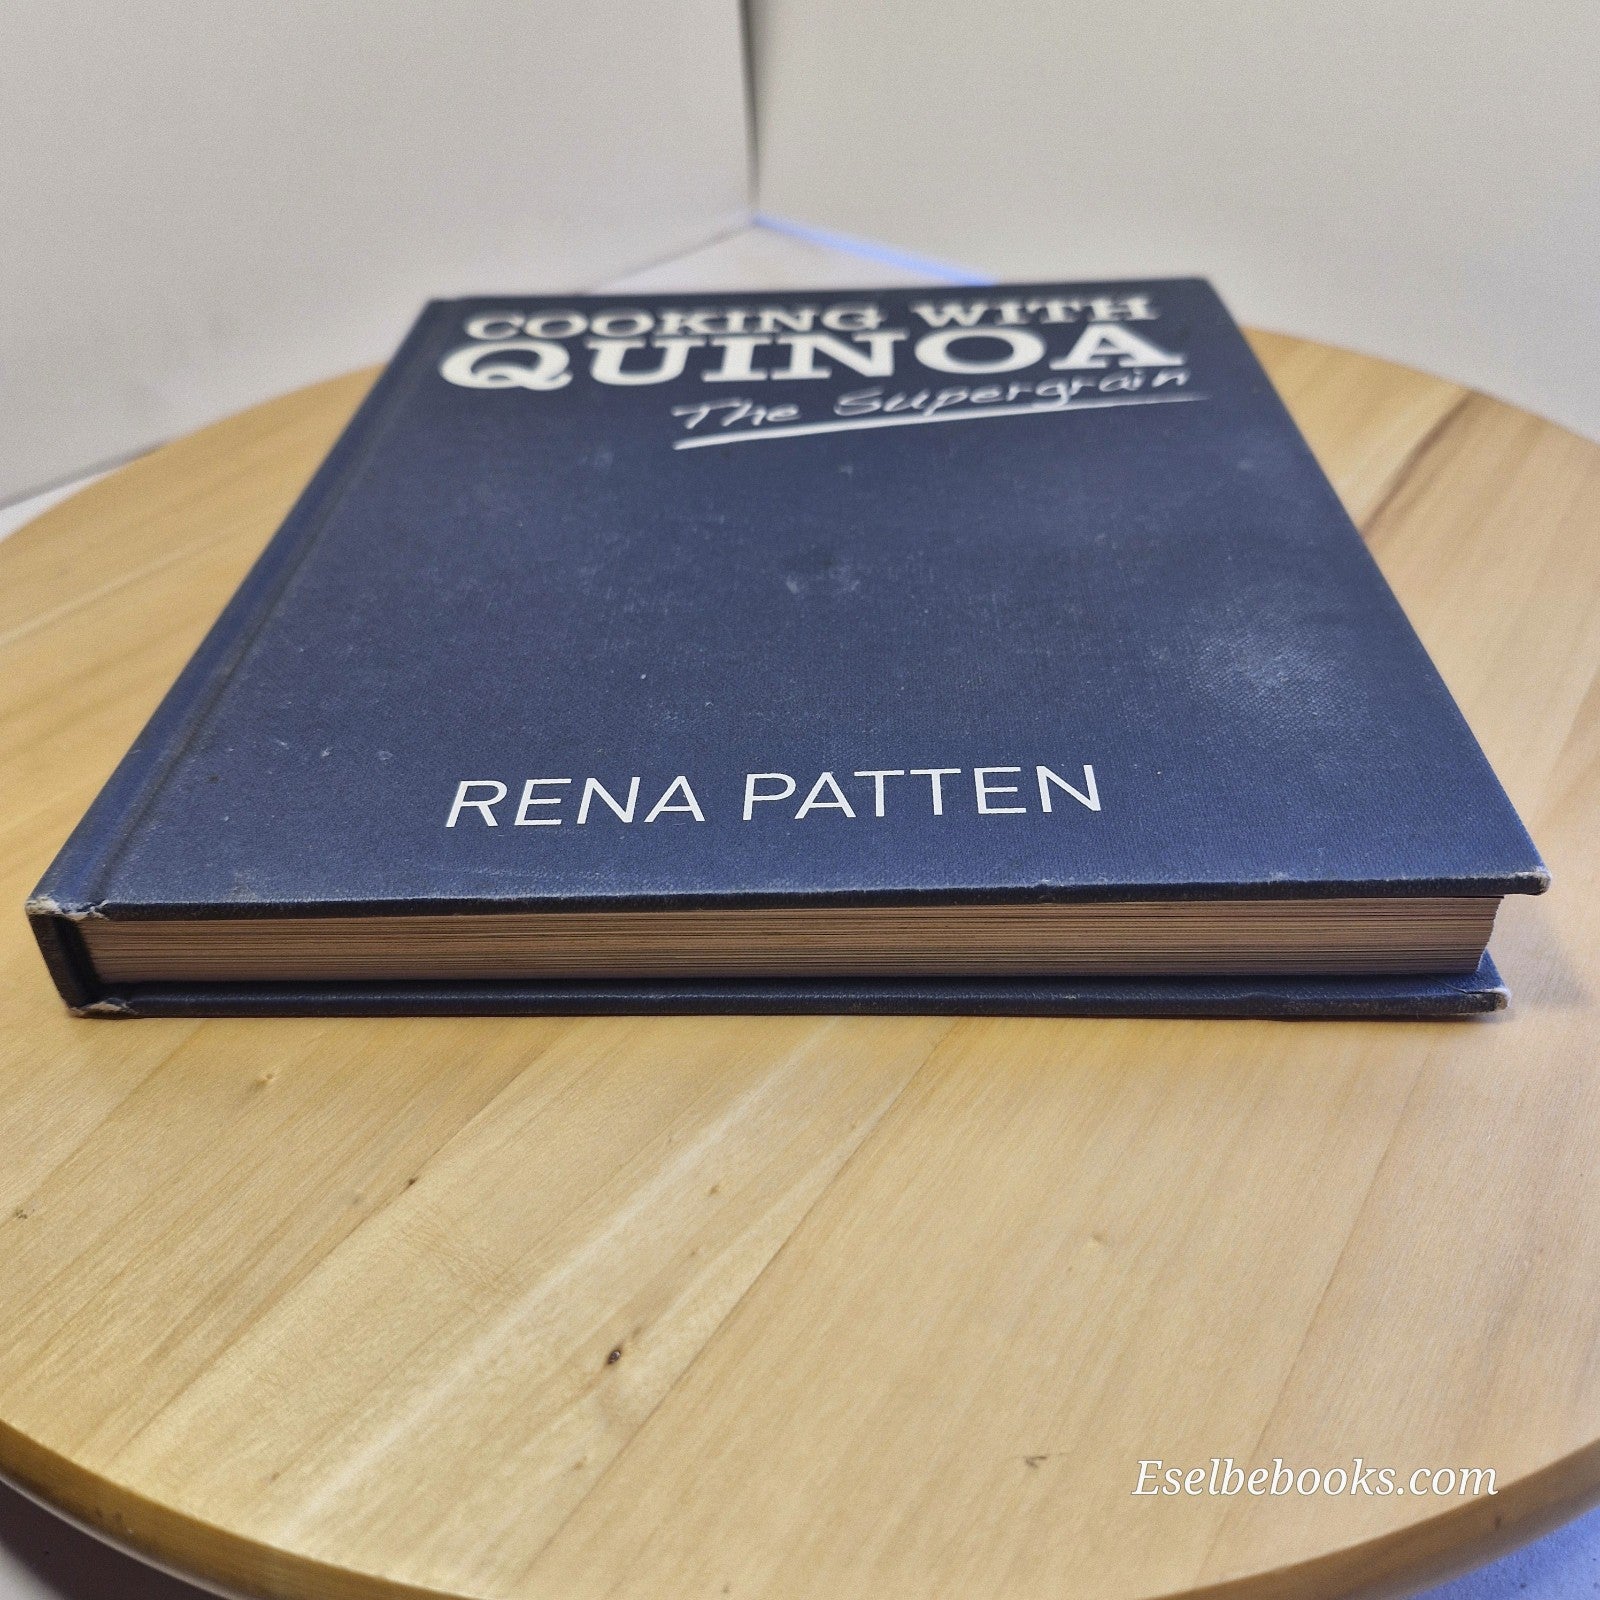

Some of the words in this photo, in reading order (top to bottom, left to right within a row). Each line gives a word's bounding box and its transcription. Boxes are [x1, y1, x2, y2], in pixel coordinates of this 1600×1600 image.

[465, 302, 884, 341] COOKING
[911, 293, 1160, 329] WITH
[439, 322, 1186, 391] QUINOA
[671, 399, 800, 430] The
[833, 366, 1190, 417] Supergrain
[445, 775, 706, 828] RENA
[742, 764, 1102, 821] PATTEN
